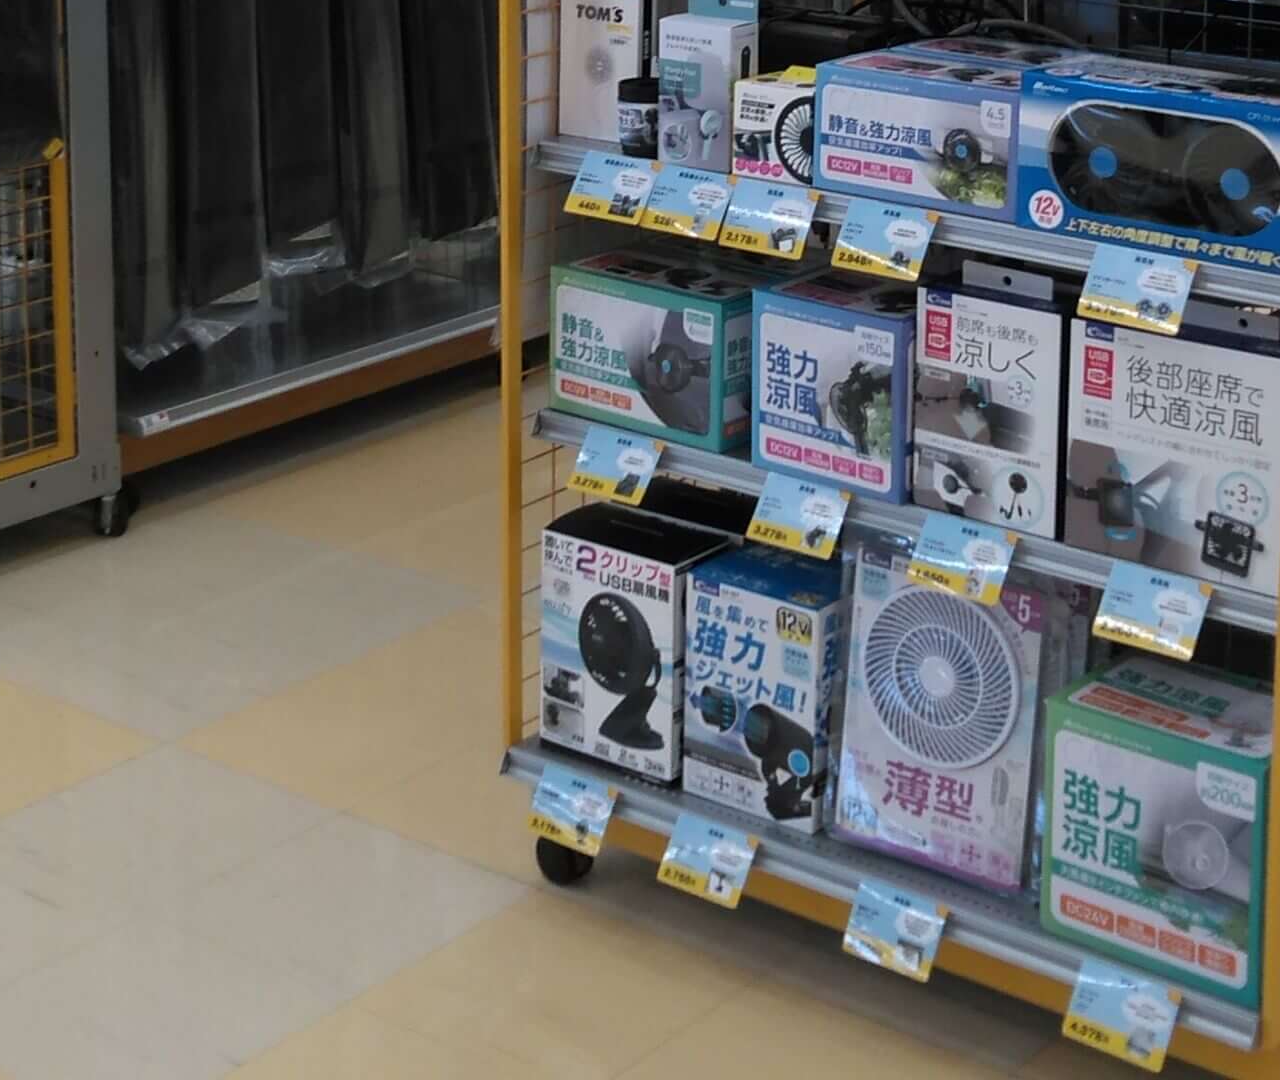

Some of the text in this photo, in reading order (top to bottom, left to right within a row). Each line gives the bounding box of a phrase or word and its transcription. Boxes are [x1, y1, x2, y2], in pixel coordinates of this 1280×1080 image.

[576, 3, 623, 23] TOM'S
[828, 114, 933, 147] 静音&強力涼風
[562, 311, 604, 342] 静音&
[561, 335, 628, 371] 強力涼風
[766, 341, 819, 383] 強力
[955, 334, 1037, 381] 涼しく
[766, 376, 818, 417] 涼風
[1127, 354, 1265, 408] 後部座席で
[1126, 386, 1264, 447] 快適涼風
[601, 551, 671, 587] クリップ型
[696, 595, 769, 633] 風を集めて
[694, 617, 767, 671] 強力
[696, 659, 807, 713] ジェット風!
[1063, 768, 1143, 831] 強力
[1061, 813, 1140, 875] 涼風
